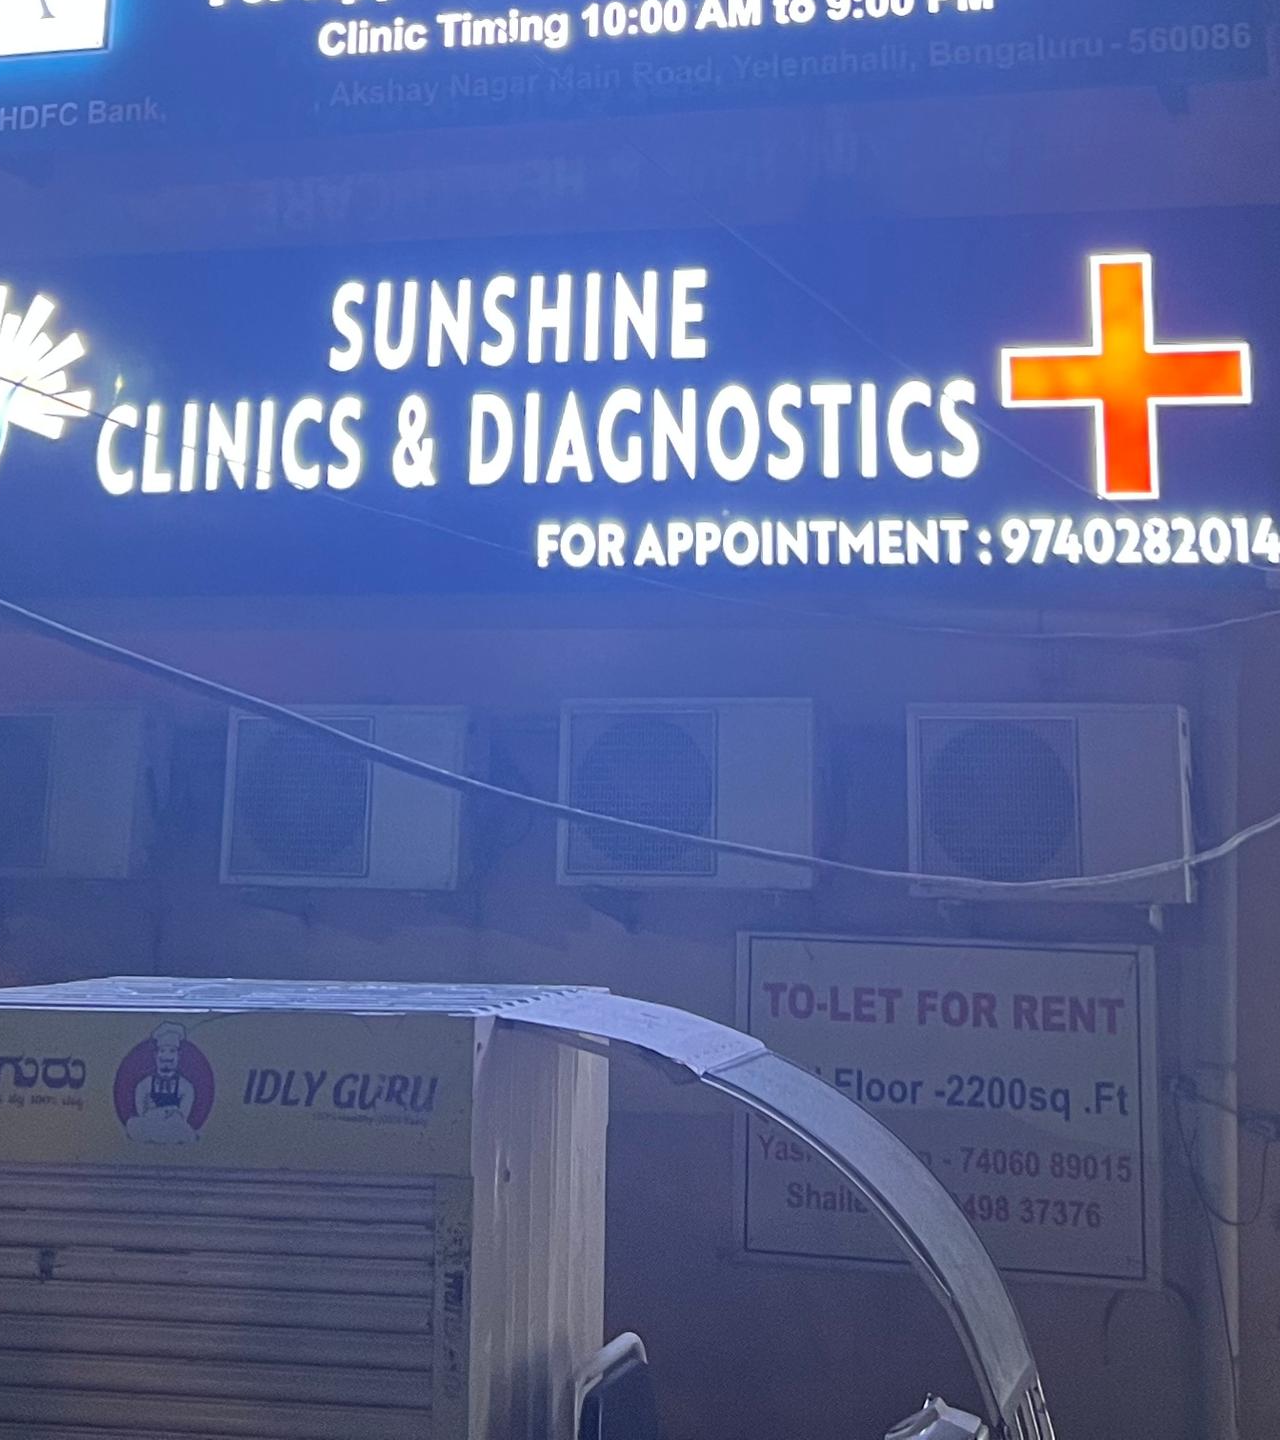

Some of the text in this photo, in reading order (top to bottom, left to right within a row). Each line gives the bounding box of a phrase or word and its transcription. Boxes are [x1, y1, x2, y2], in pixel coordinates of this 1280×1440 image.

[318, 17, 427, 57] Clinic
[437, 8, 569, 49] Timing
[329, 76, 438, 108] Akshay
[450, 70, 539, 102] Nagar
[548, 62, 619, 92] Main
[632, 55, 721, 87] Road,
[87, 97, 167, 126] Bank,
[328, 266, 708, 372] SUNSHINE
[96, 379, 980, 495] CLINICS & DIAGNOSTICS
[537, 521, 625, 568] FOR
[633, 517, 968, 567] APPOINTMENT
[762, 981, 1125, 1035] TO-LET FOR RENT
[242, 1068, 439, 1112] IDLY GURU
[835, 1067, 925, 1105] Floor
[960, 1146, 1041, 1178] 74060
[1051, 1151, 1133, 1183] 89015
[1022, 1197, 1102, 1228] 37376
